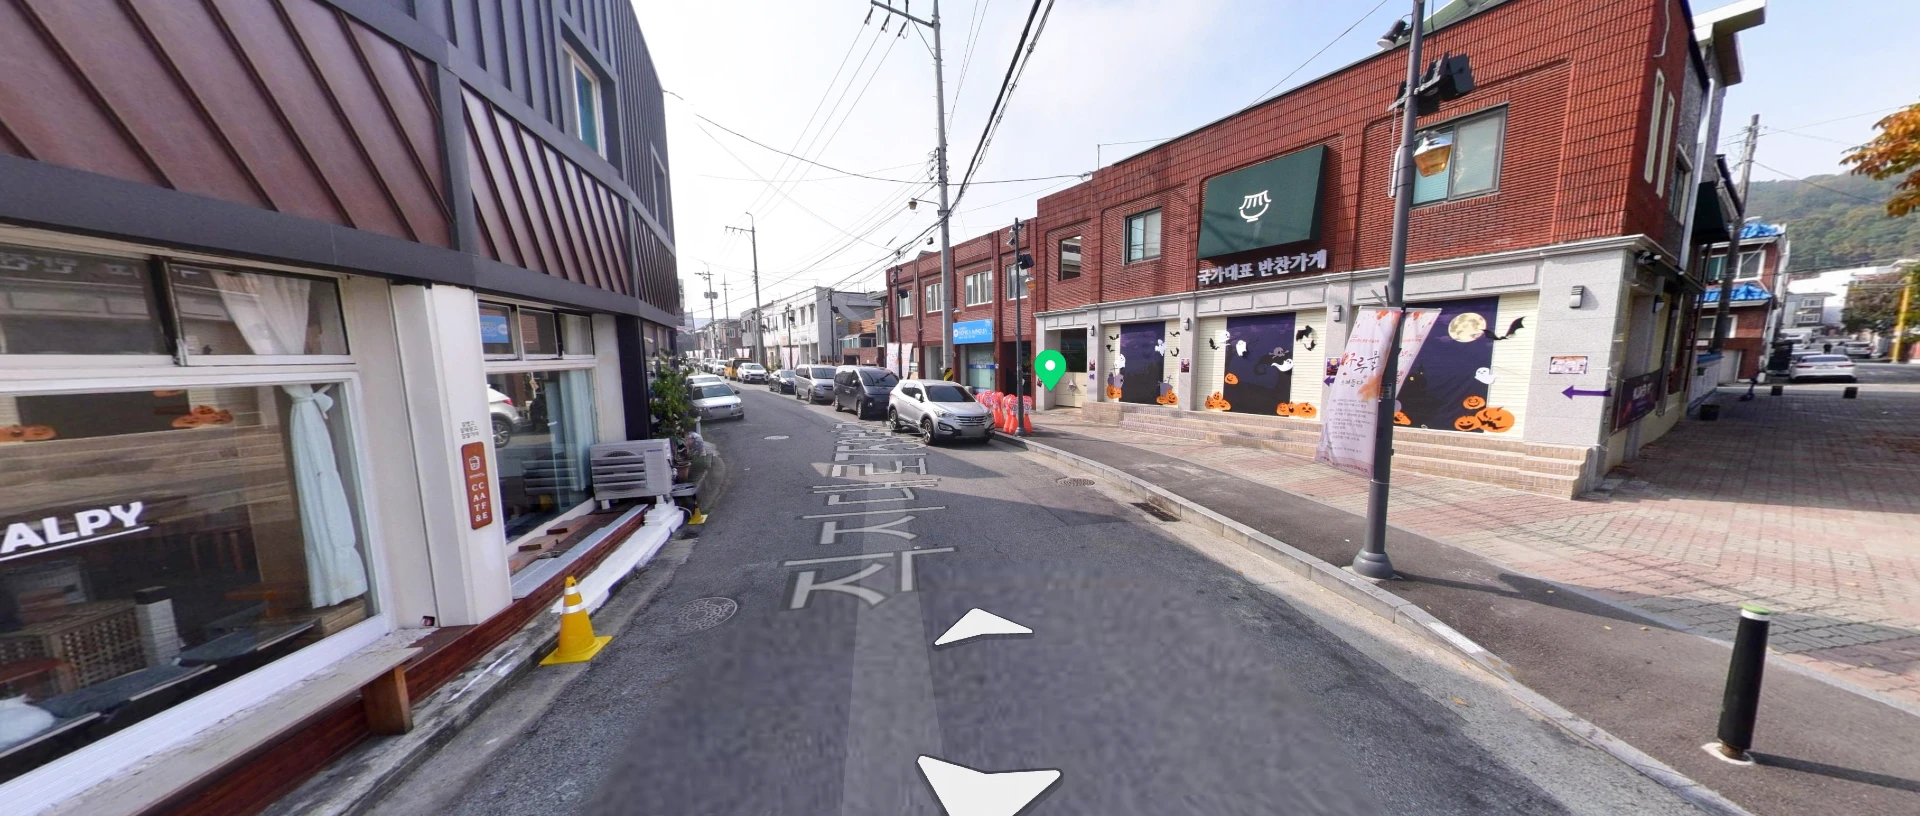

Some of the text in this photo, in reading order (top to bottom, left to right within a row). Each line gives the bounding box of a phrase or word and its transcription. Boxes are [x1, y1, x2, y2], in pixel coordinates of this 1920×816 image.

[1197, 249, 1328, 285] 국가대표 반찬가게
[0, 500, 144, 554] ALPY
